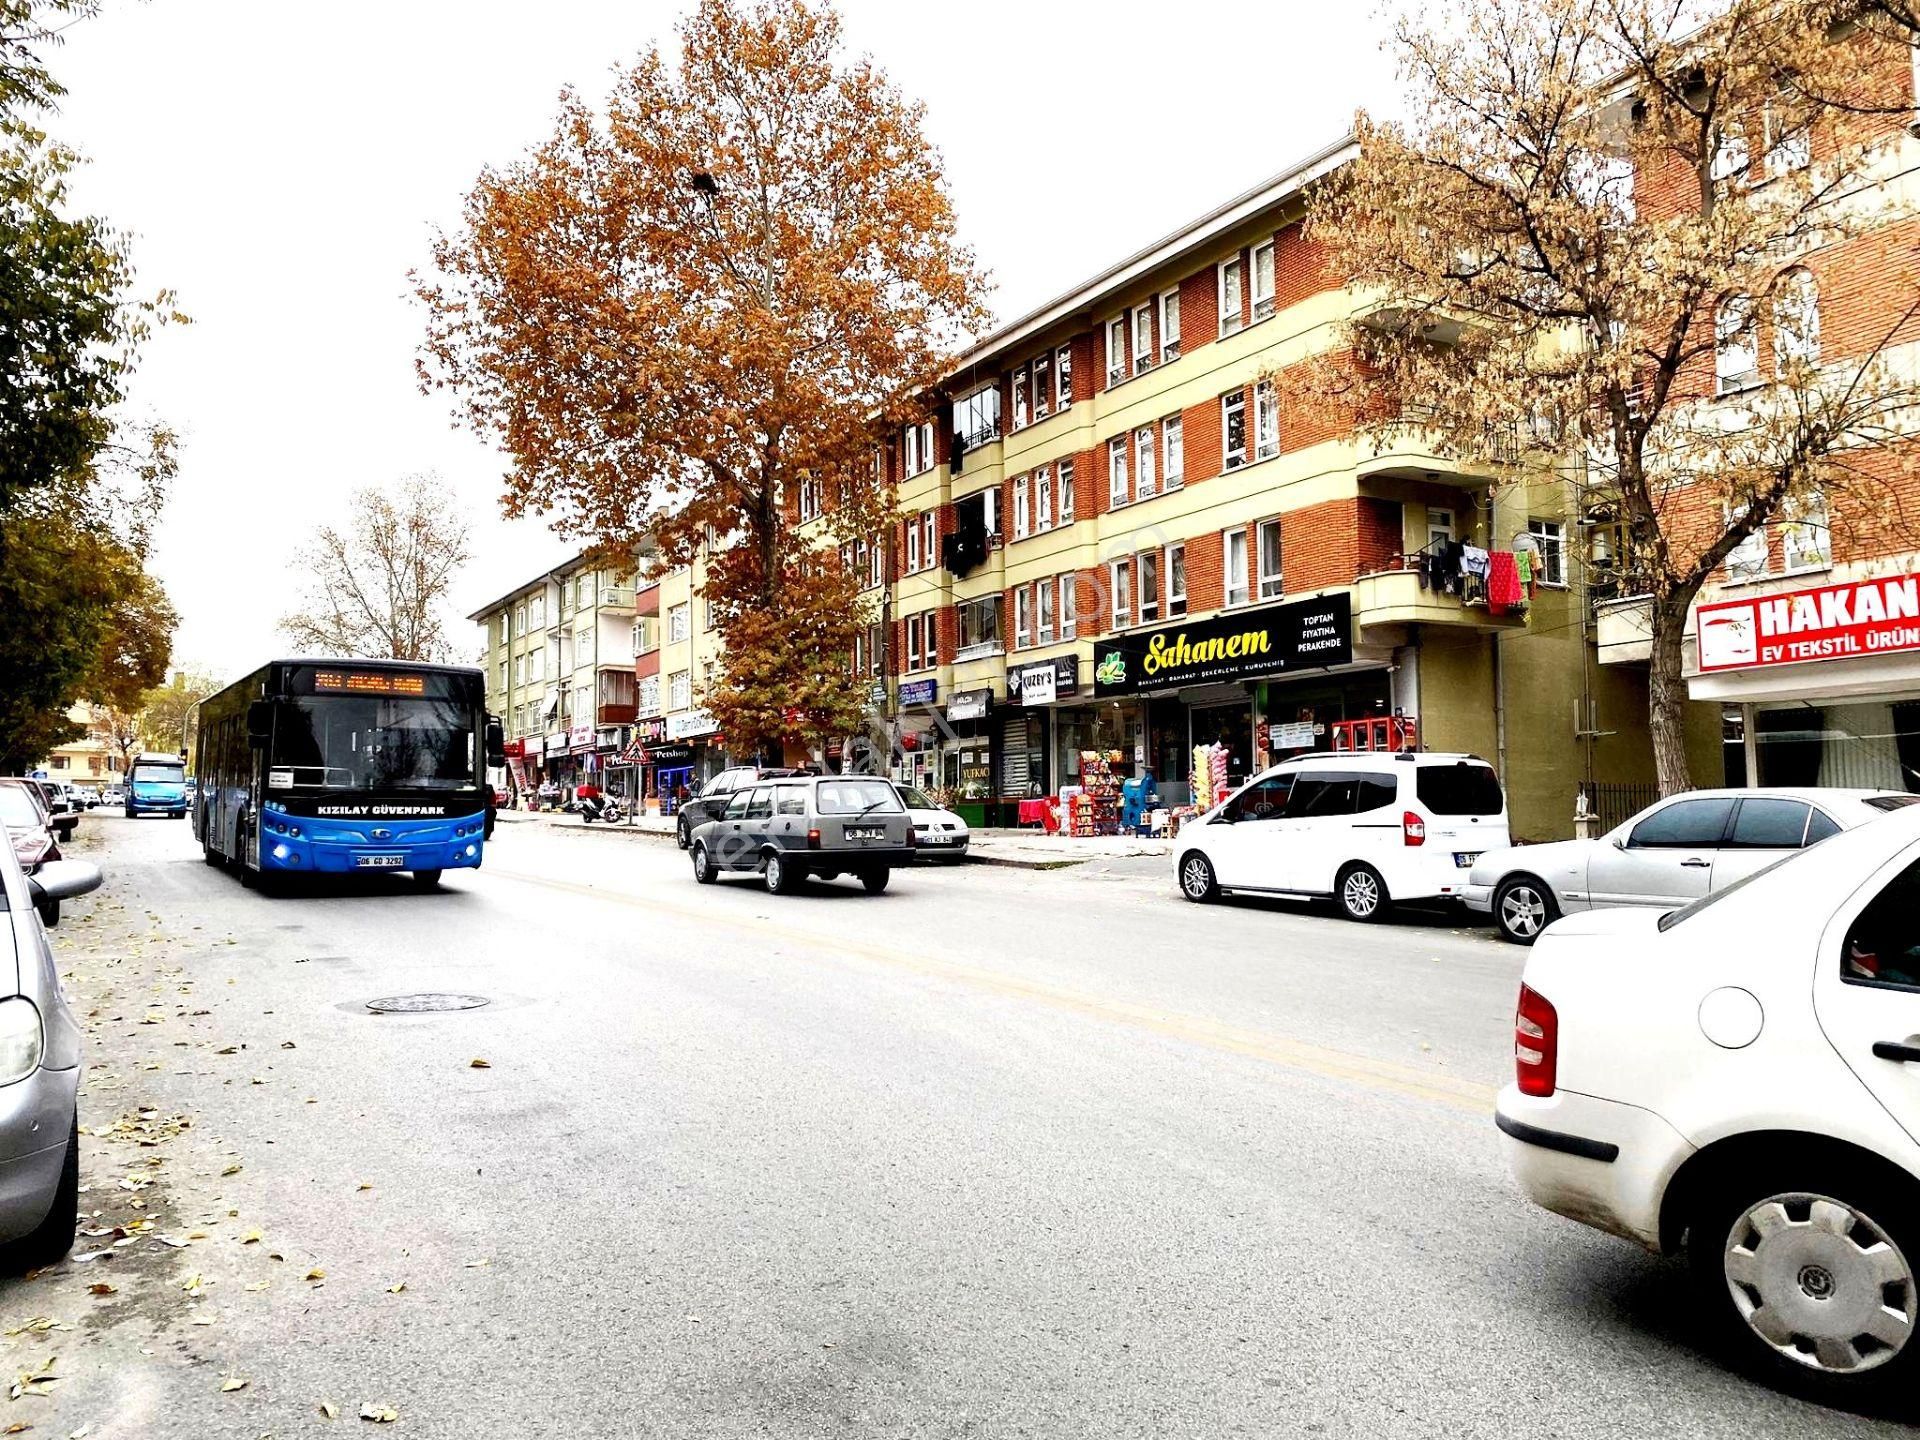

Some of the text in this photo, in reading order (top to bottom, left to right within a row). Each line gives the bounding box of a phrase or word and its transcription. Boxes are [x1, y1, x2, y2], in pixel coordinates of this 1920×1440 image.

[1759, 579, 1920, 637] HAKAN
[1304, 613, 1334, 626] TOPTAN
[1297, 638, 1342, 652] PERAKENDE
[1763, 626, 1920, 662] EV TEKSTİL ÜRÜN
[1143, 629, 1271, 675] Sahanem
[1023, 671, 1052, 690] KUZEY'S
[656, 749, 688, 760] Petshop
[317, 804, 445, 815] KIZILAY GÜVENPARK
[360, 857, 370, 866] 06
[385, 856, 403, 866] 3292
